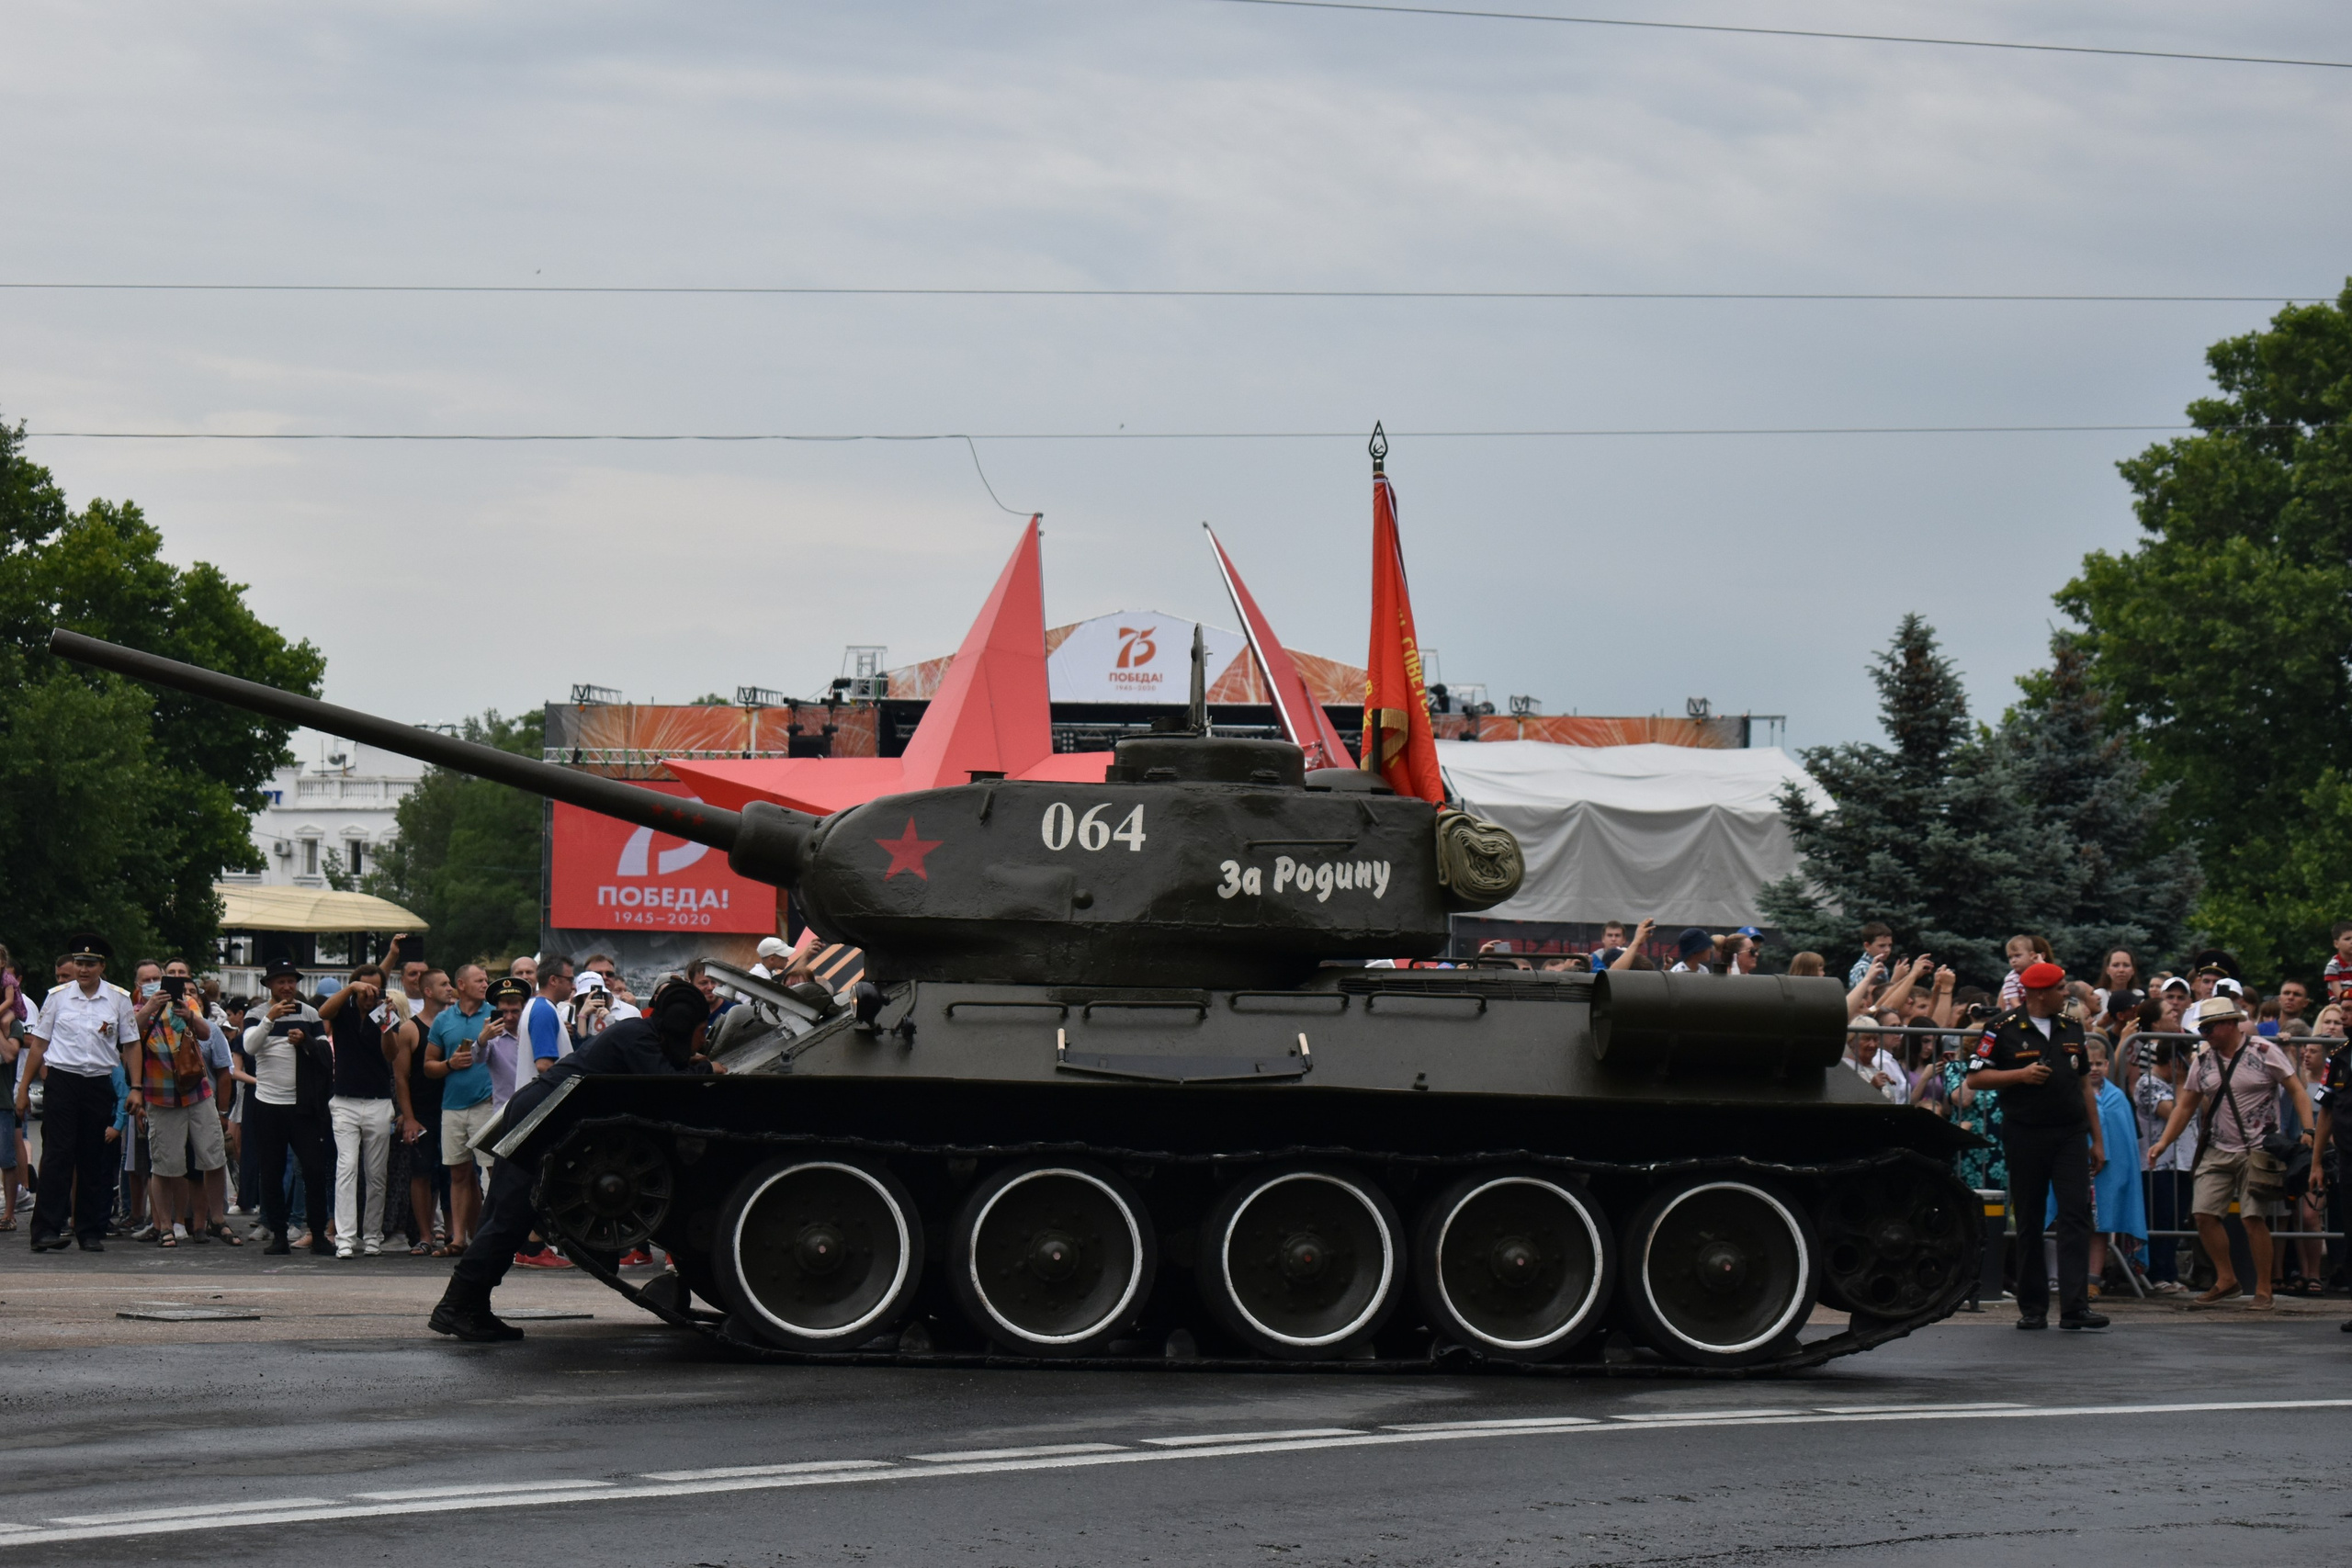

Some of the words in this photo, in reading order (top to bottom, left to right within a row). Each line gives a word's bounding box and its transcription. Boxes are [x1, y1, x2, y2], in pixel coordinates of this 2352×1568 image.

[1116, 626, 1157, 669] 75
[1109, 672, 1163, 683] ПОБЕДА!
[1042, 802, 1147, 852] 064
[597, 886, 729, 912] ПОБЕДА!
[1217, 860, 1261, 899] За
[1273, 855, 1391, 903] Родину
